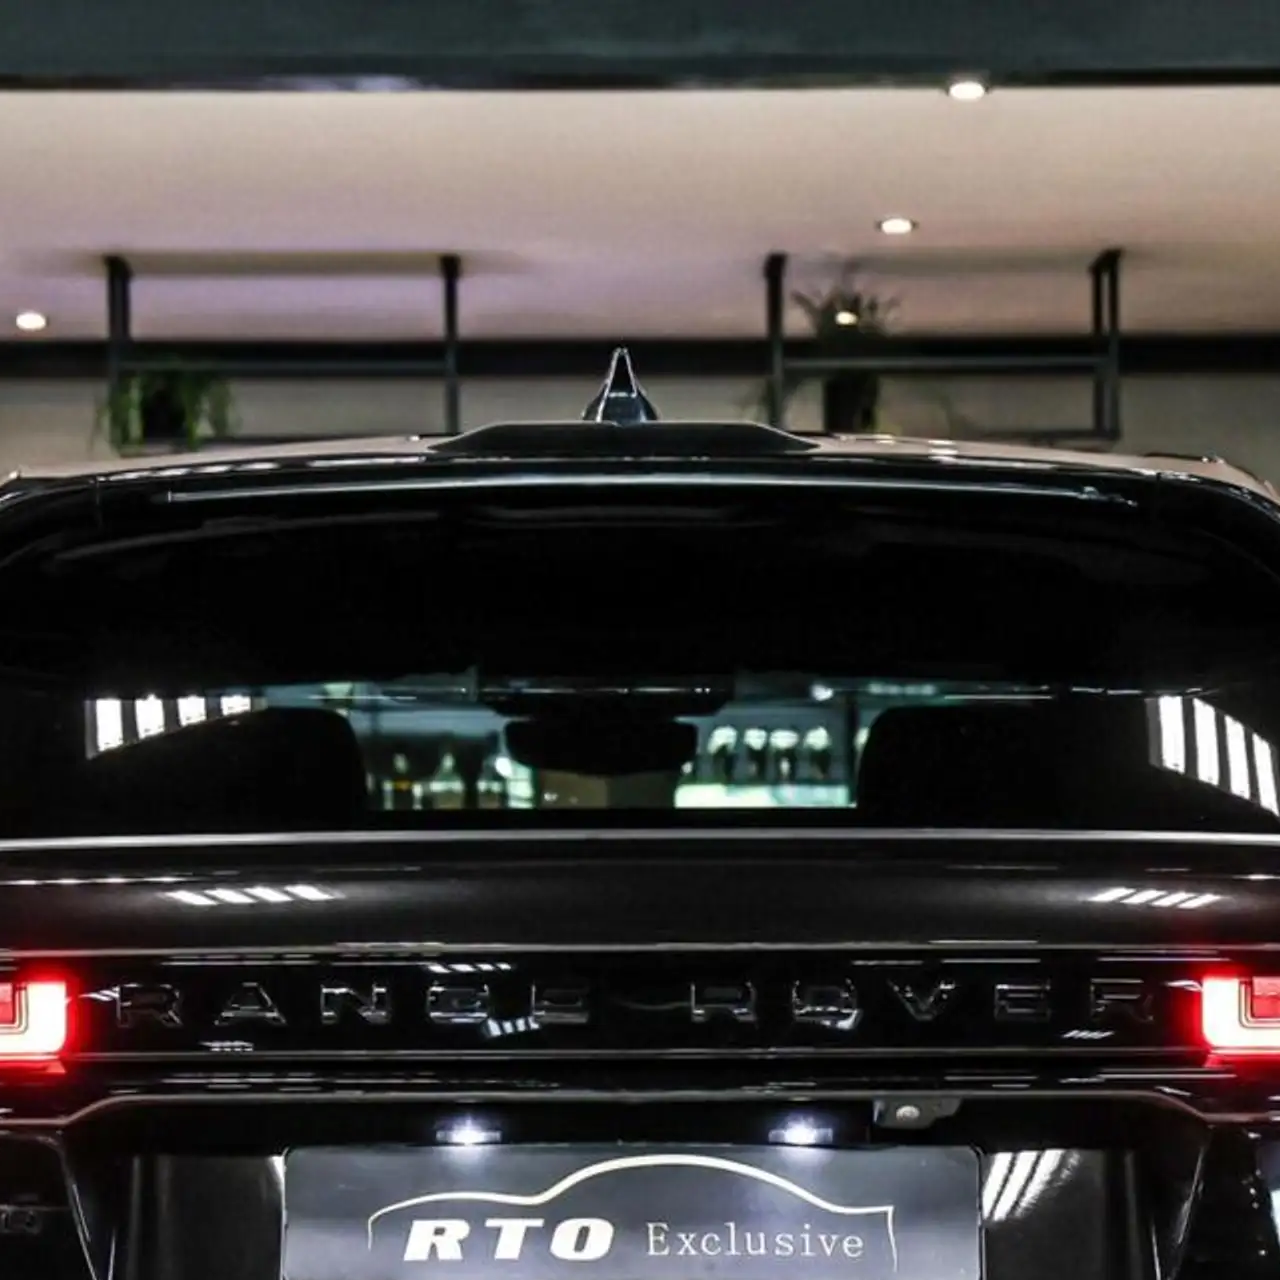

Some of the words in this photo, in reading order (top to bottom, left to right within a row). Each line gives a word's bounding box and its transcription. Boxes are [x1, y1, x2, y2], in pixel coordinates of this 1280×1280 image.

[118, 982, 589, 1025] RANGE
[690, 980, 1154, 1023] ROVER
[402, 1217, 615, 1262] RTO
[646, 1222, 866, 1259] Exclusive
